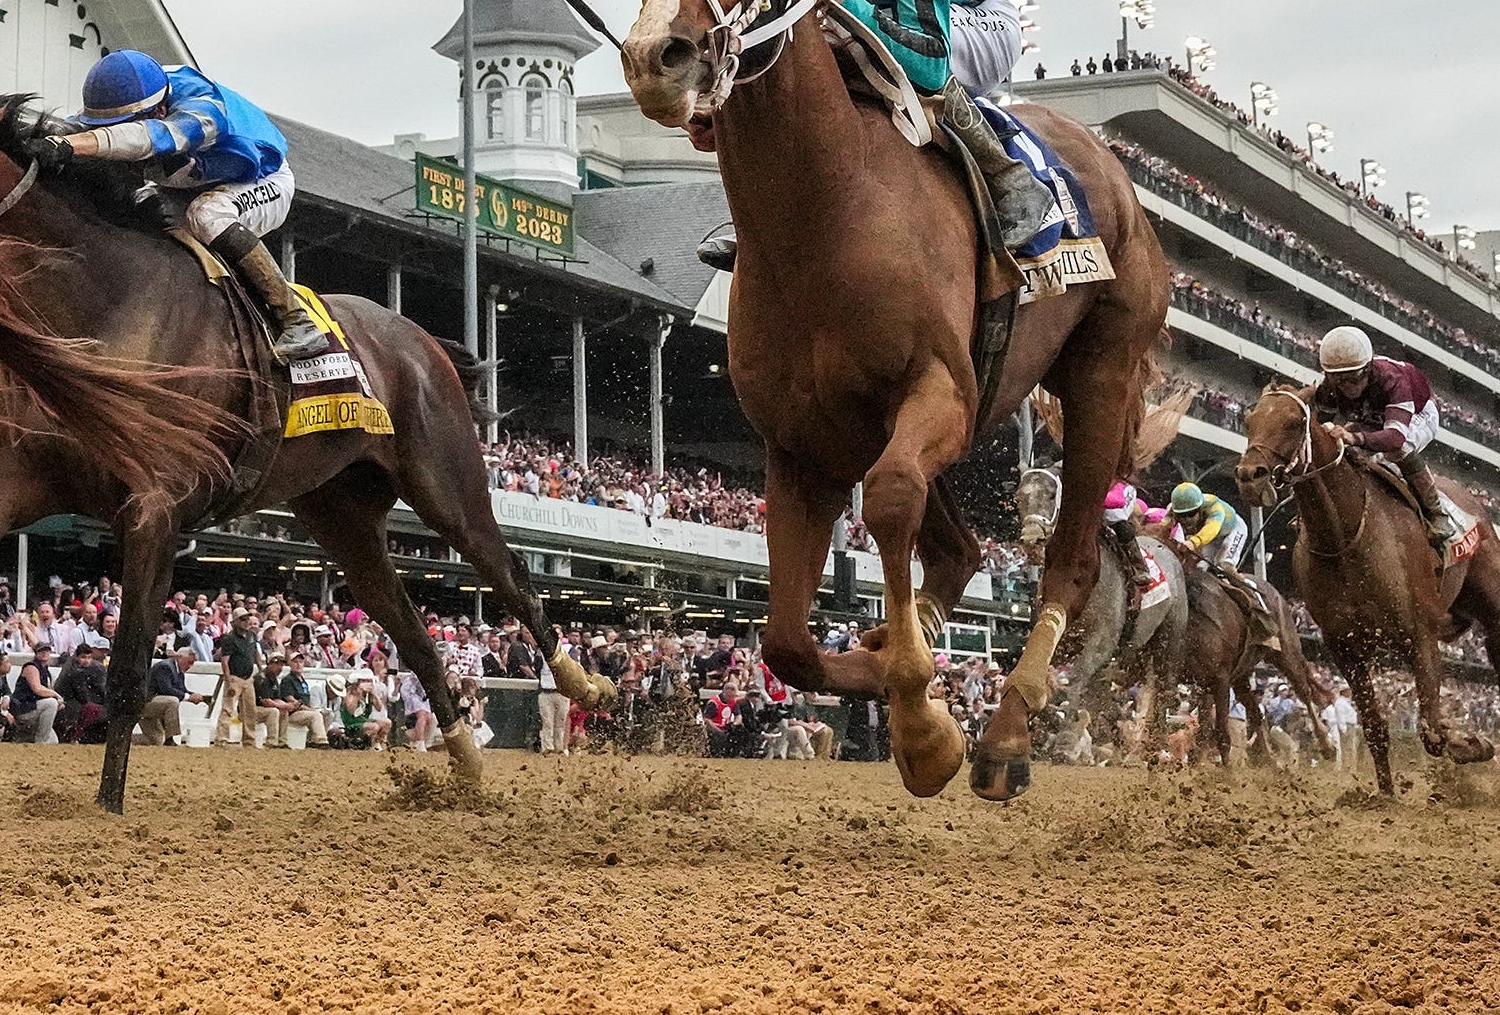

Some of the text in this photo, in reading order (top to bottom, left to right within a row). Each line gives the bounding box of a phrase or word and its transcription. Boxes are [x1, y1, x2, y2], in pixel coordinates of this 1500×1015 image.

[422, 166, 486, 199] FIRST DBY
[535, 205, 569, 226] DERBY
[516, 214, 563, 245] 2023
[296, 367, 348, 382] RESERVE
[338, 400, 360, 423] OF
[499, 496, 558, 526] CHURCHILL
[561, 506, 598, 532] DOWNS
